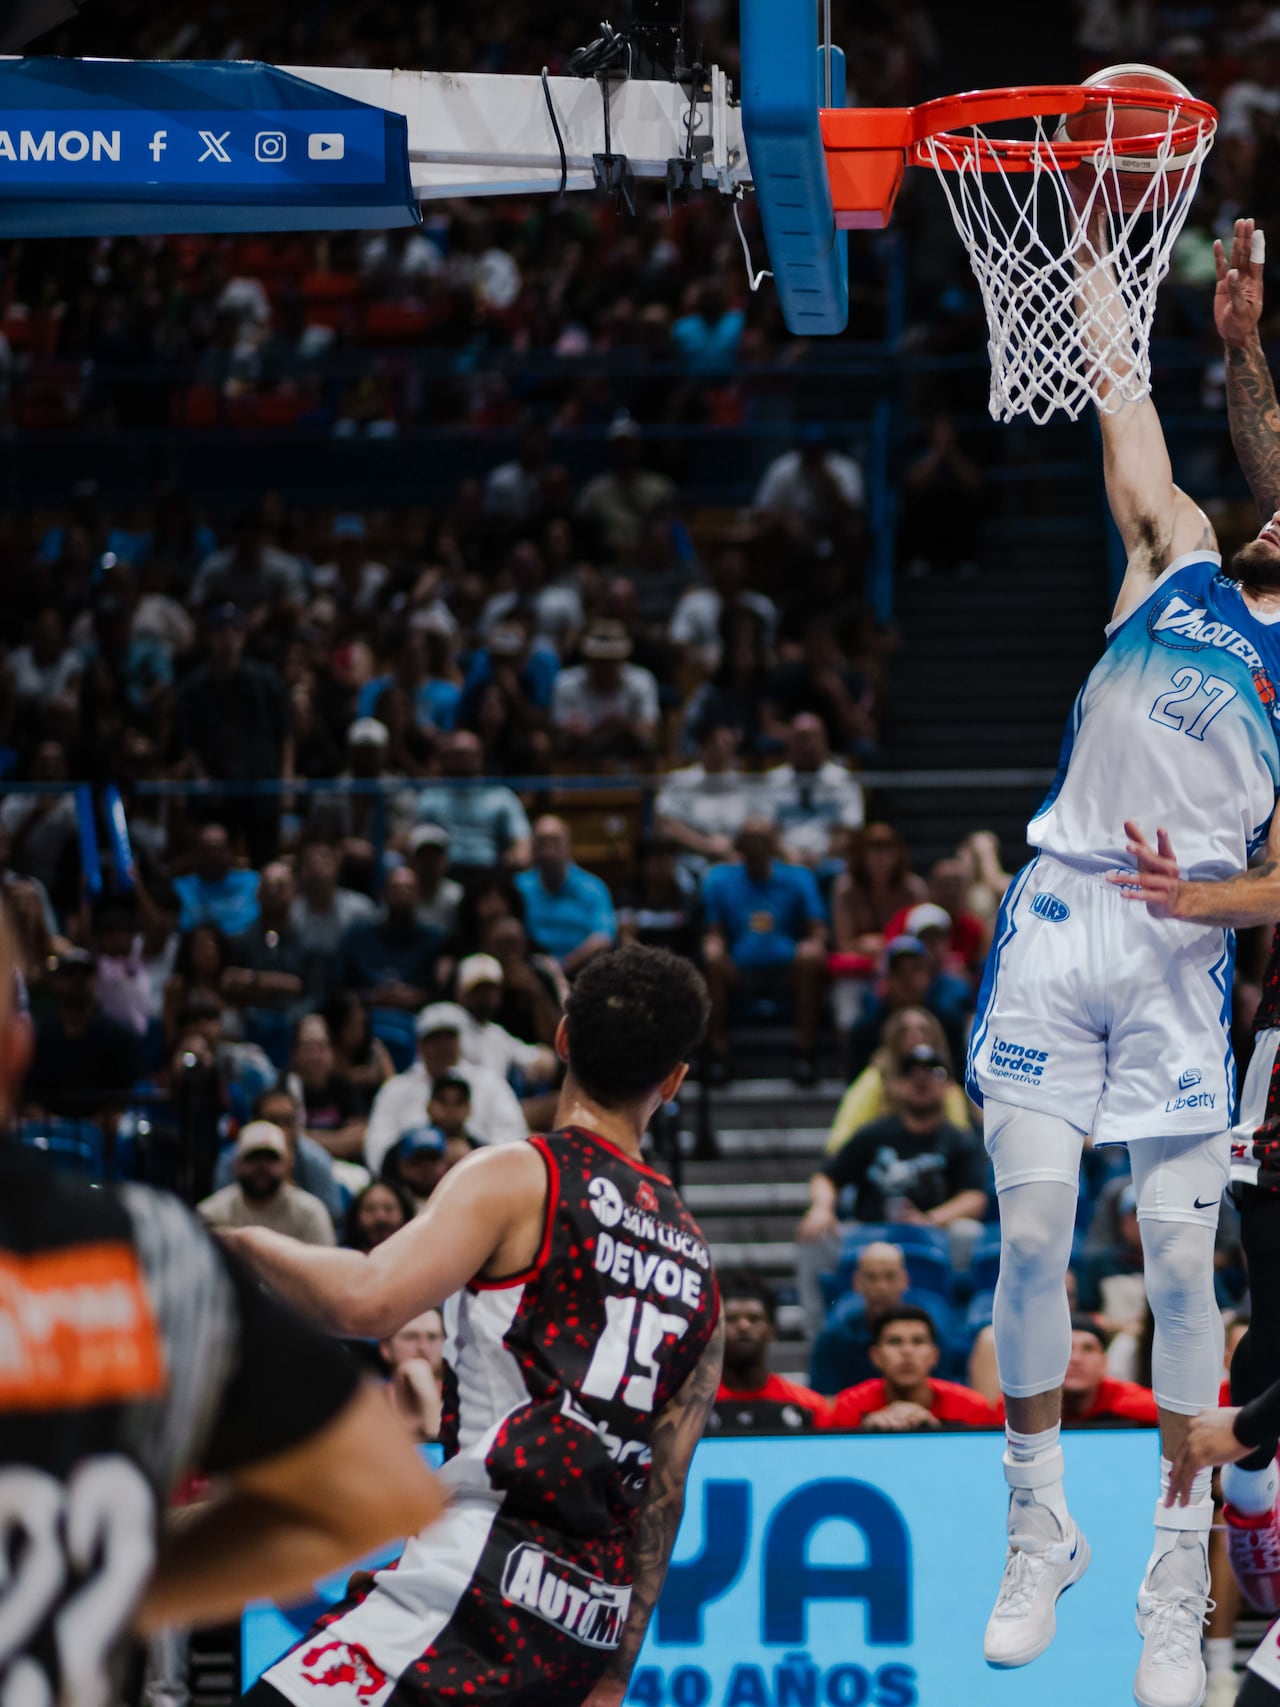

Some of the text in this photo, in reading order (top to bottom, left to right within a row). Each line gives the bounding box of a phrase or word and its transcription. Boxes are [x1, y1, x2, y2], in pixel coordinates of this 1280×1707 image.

[0, 131, 121, 161] AMON
[1149, 666, 1238, 742] 27
[990, 1050, 1045, 1076] Verdes
[993, 1036, 1049, 1062] Lomas
[986, 1064, 1041, 1086] Cooperativa
[1165, 1090, 1216, 1112] Liberty
[622, 1207, 656, 1240] SAN
[595, 1231, 702, 1311] DEVOE
[580, 1295, 690, 1412] 15
[632, 1650, 919, 1707] 40 AÑOS
